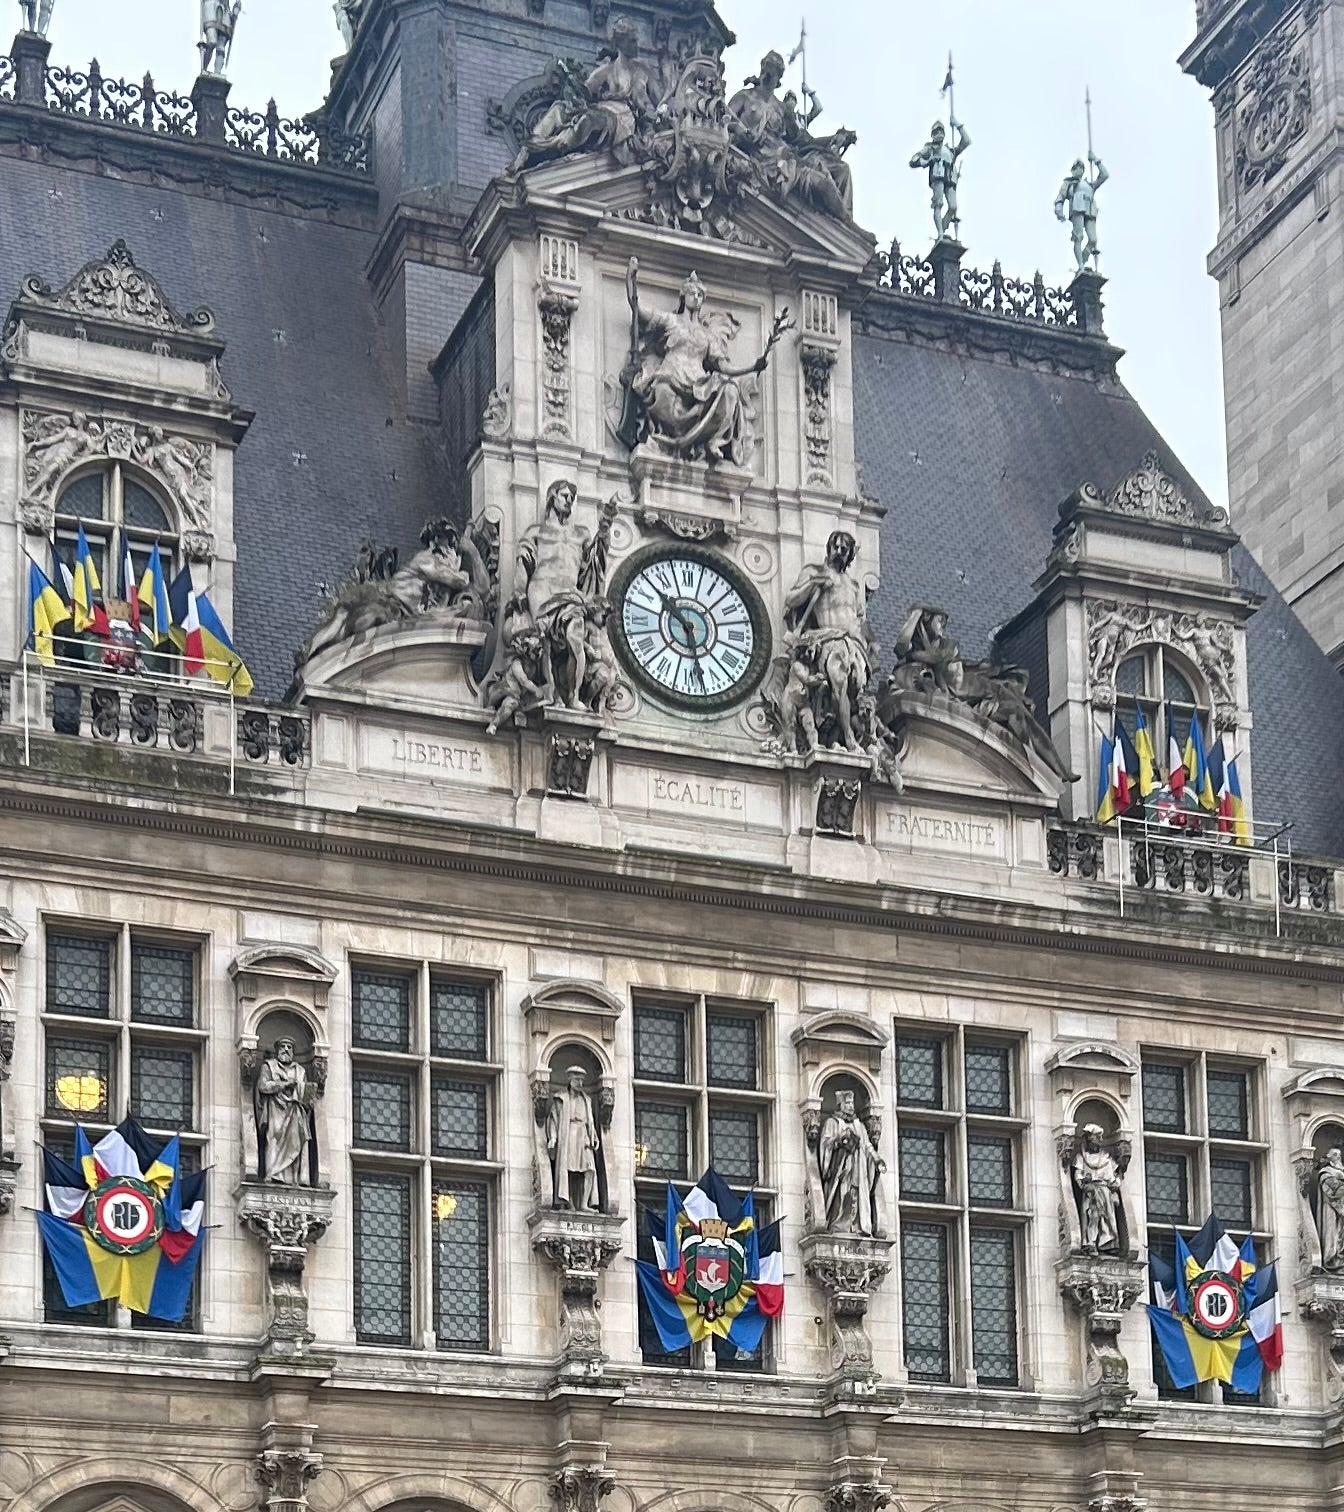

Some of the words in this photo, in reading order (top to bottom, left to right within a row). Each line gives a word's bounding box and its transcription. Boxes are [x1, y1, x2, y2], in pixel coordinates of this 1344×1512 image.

[391, 738, 482, 773] LIBERTÉ
[886, 812, 996, 847] FRATERNITÉ
[111, 1201, 142, 1231] RF
[1206, 1292, 1229, 1318] RF
